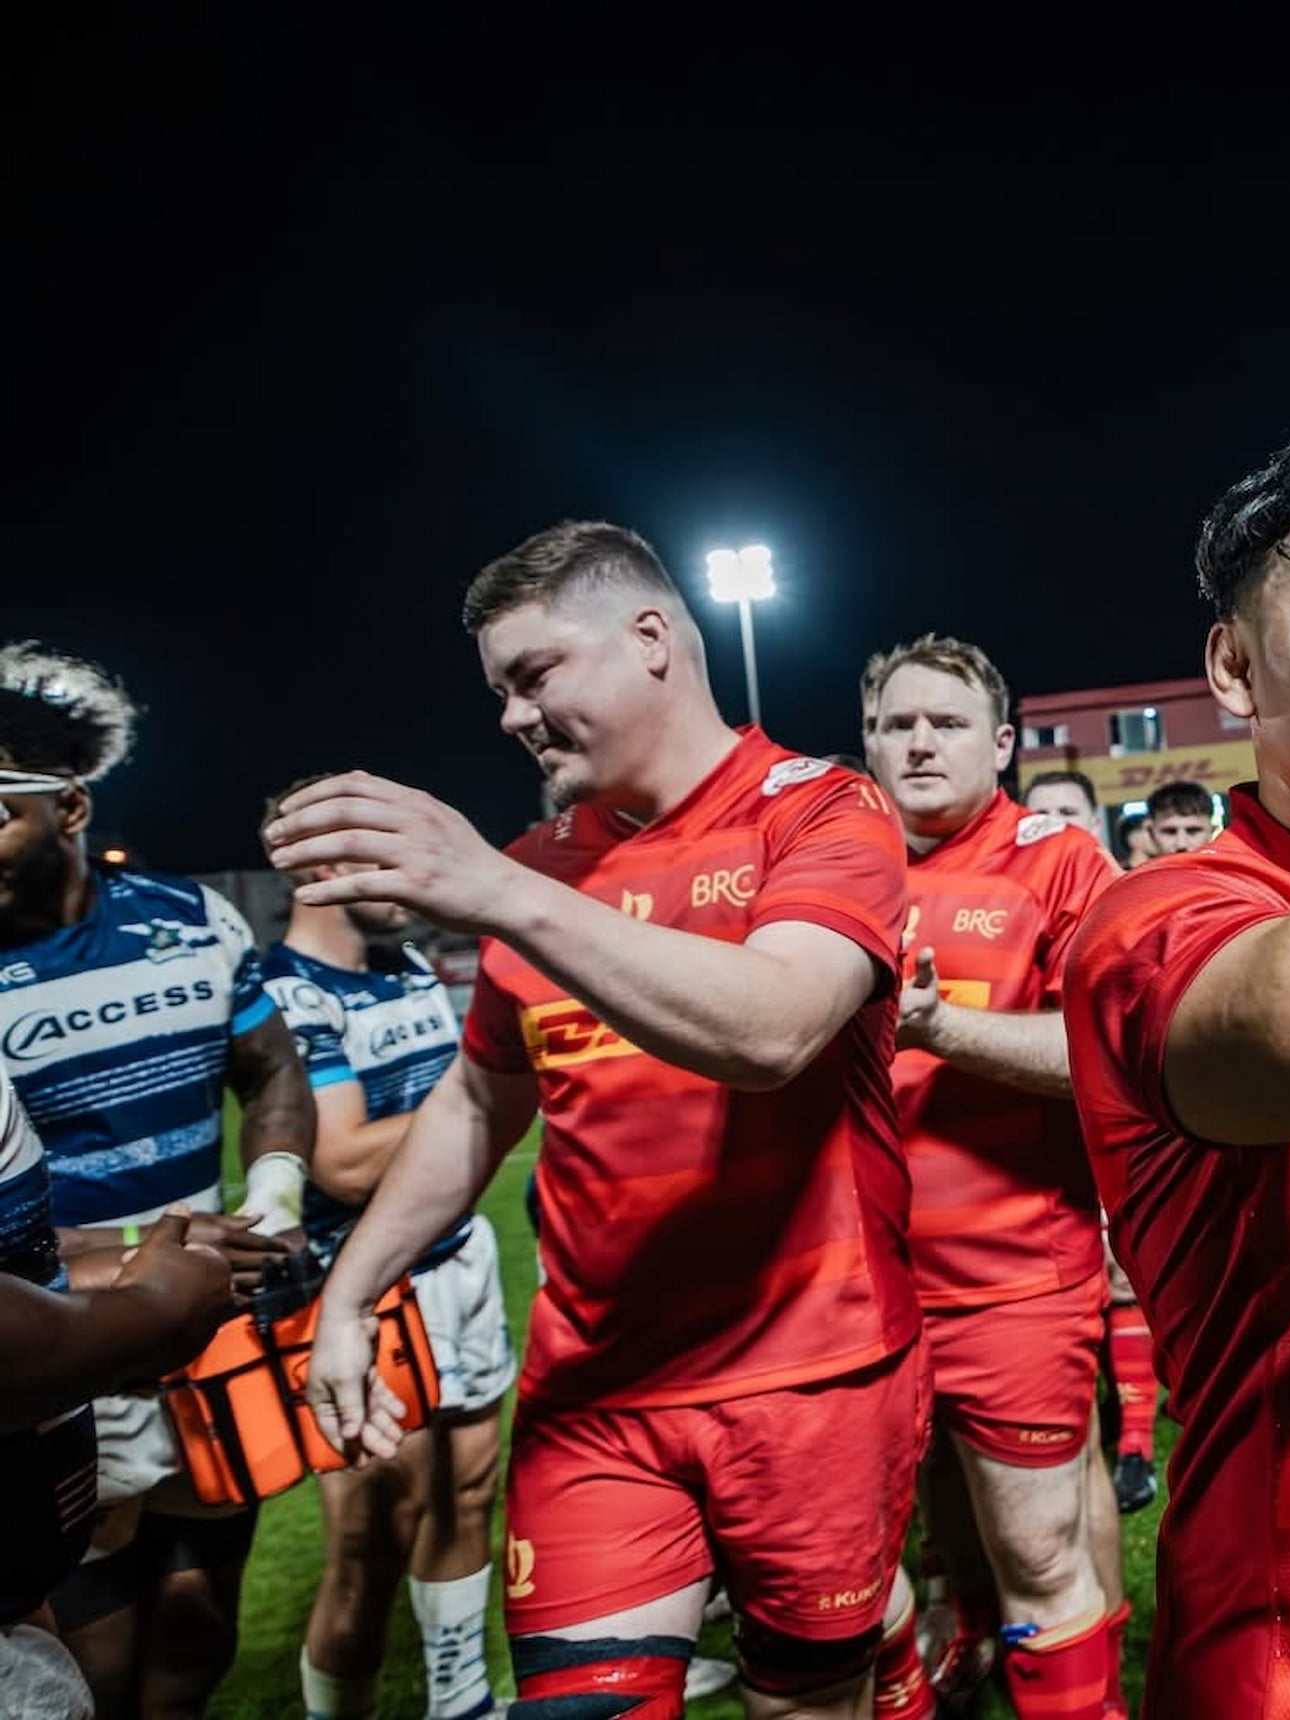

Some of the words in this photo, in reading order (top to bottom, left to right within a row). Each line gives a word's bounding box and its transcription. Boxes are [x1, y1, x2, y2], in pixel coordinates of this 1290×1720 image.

[691, 864, 757, 909] BRC
[953, 907, 1009, 941] BRC
[15, 980, 214, 1051] ACCESS
